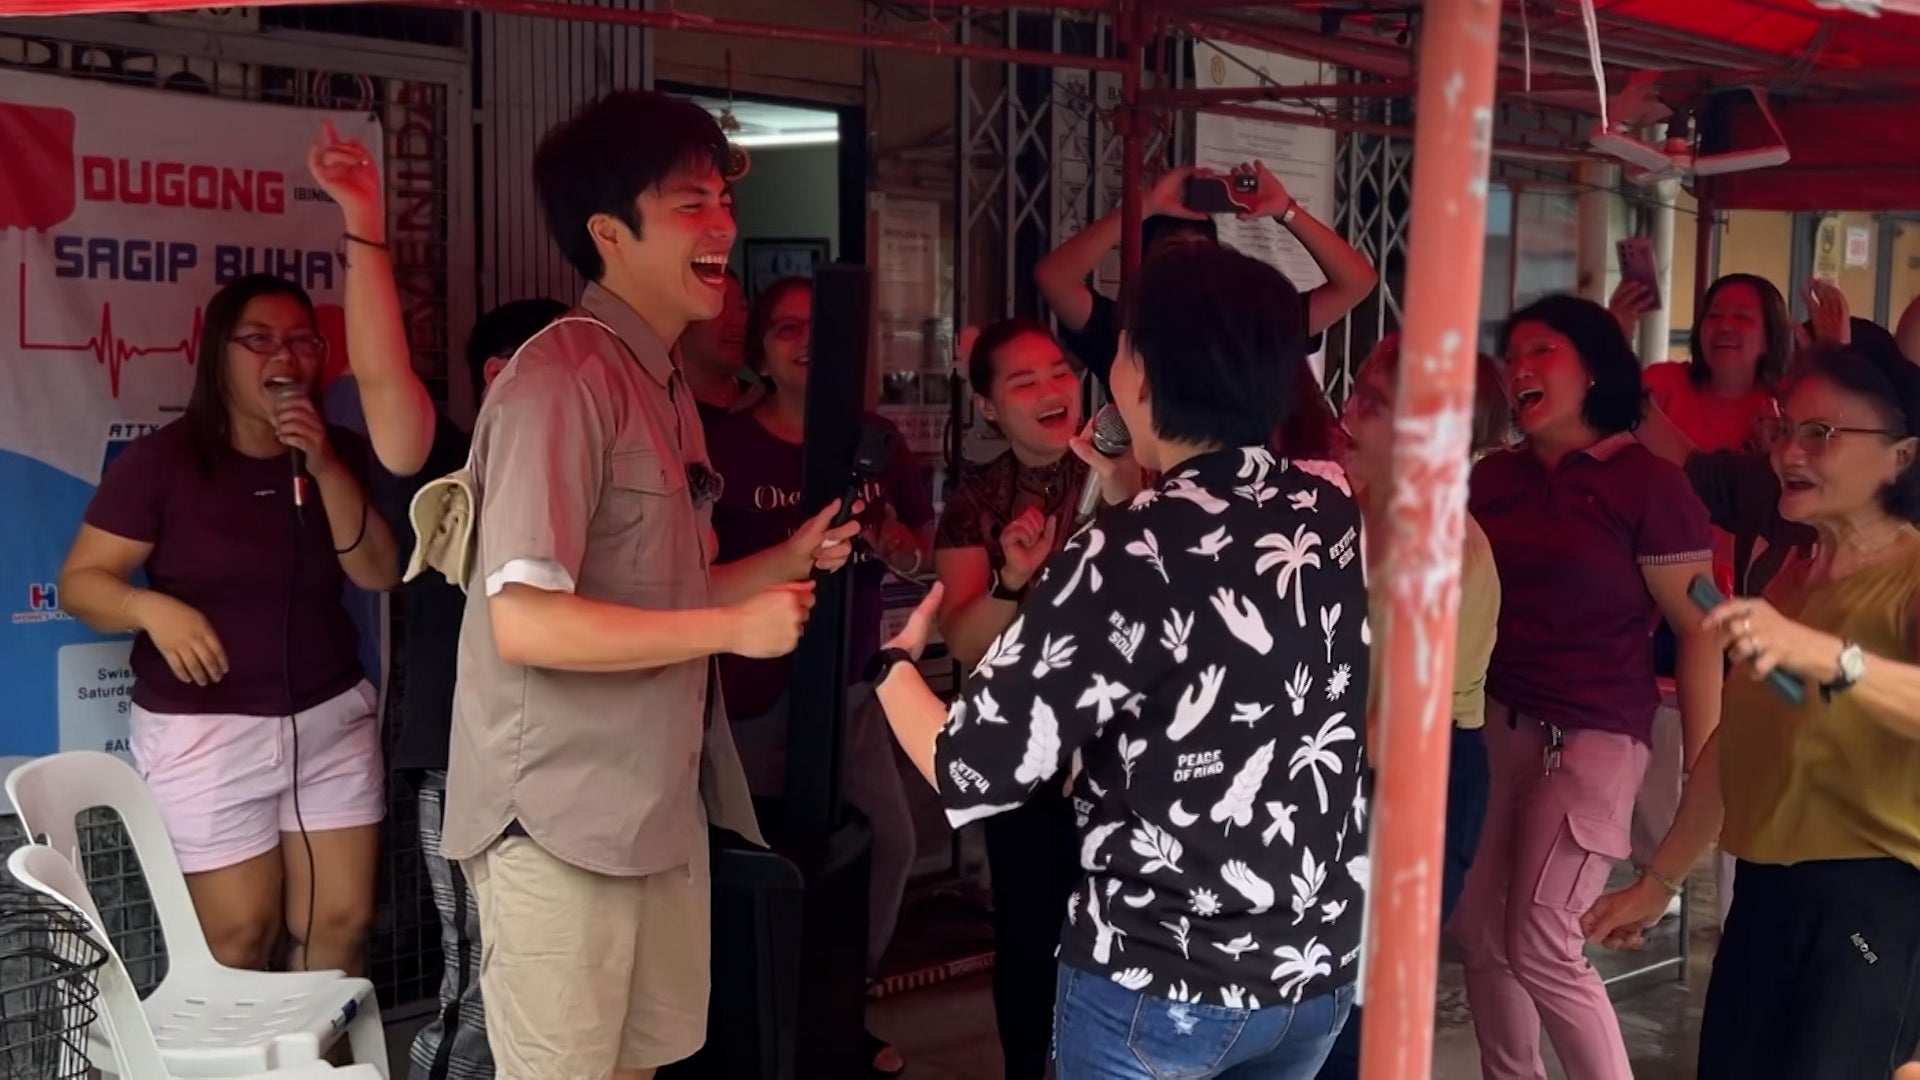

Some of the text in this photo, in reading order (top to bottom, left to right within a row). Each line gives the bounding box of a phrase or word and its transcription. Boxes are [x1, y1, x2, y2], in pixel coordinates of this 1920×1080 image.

[82, 156, 285, 214] DUGONG
[54, 236, 198, 283] SAGIP
[97, 667, 132, 681] Swis
[78, 685, 133, 700] Saturda
[1178, 750, 1222, 767] PEACE
[1173, 761, 1225, 782] OF MIND
